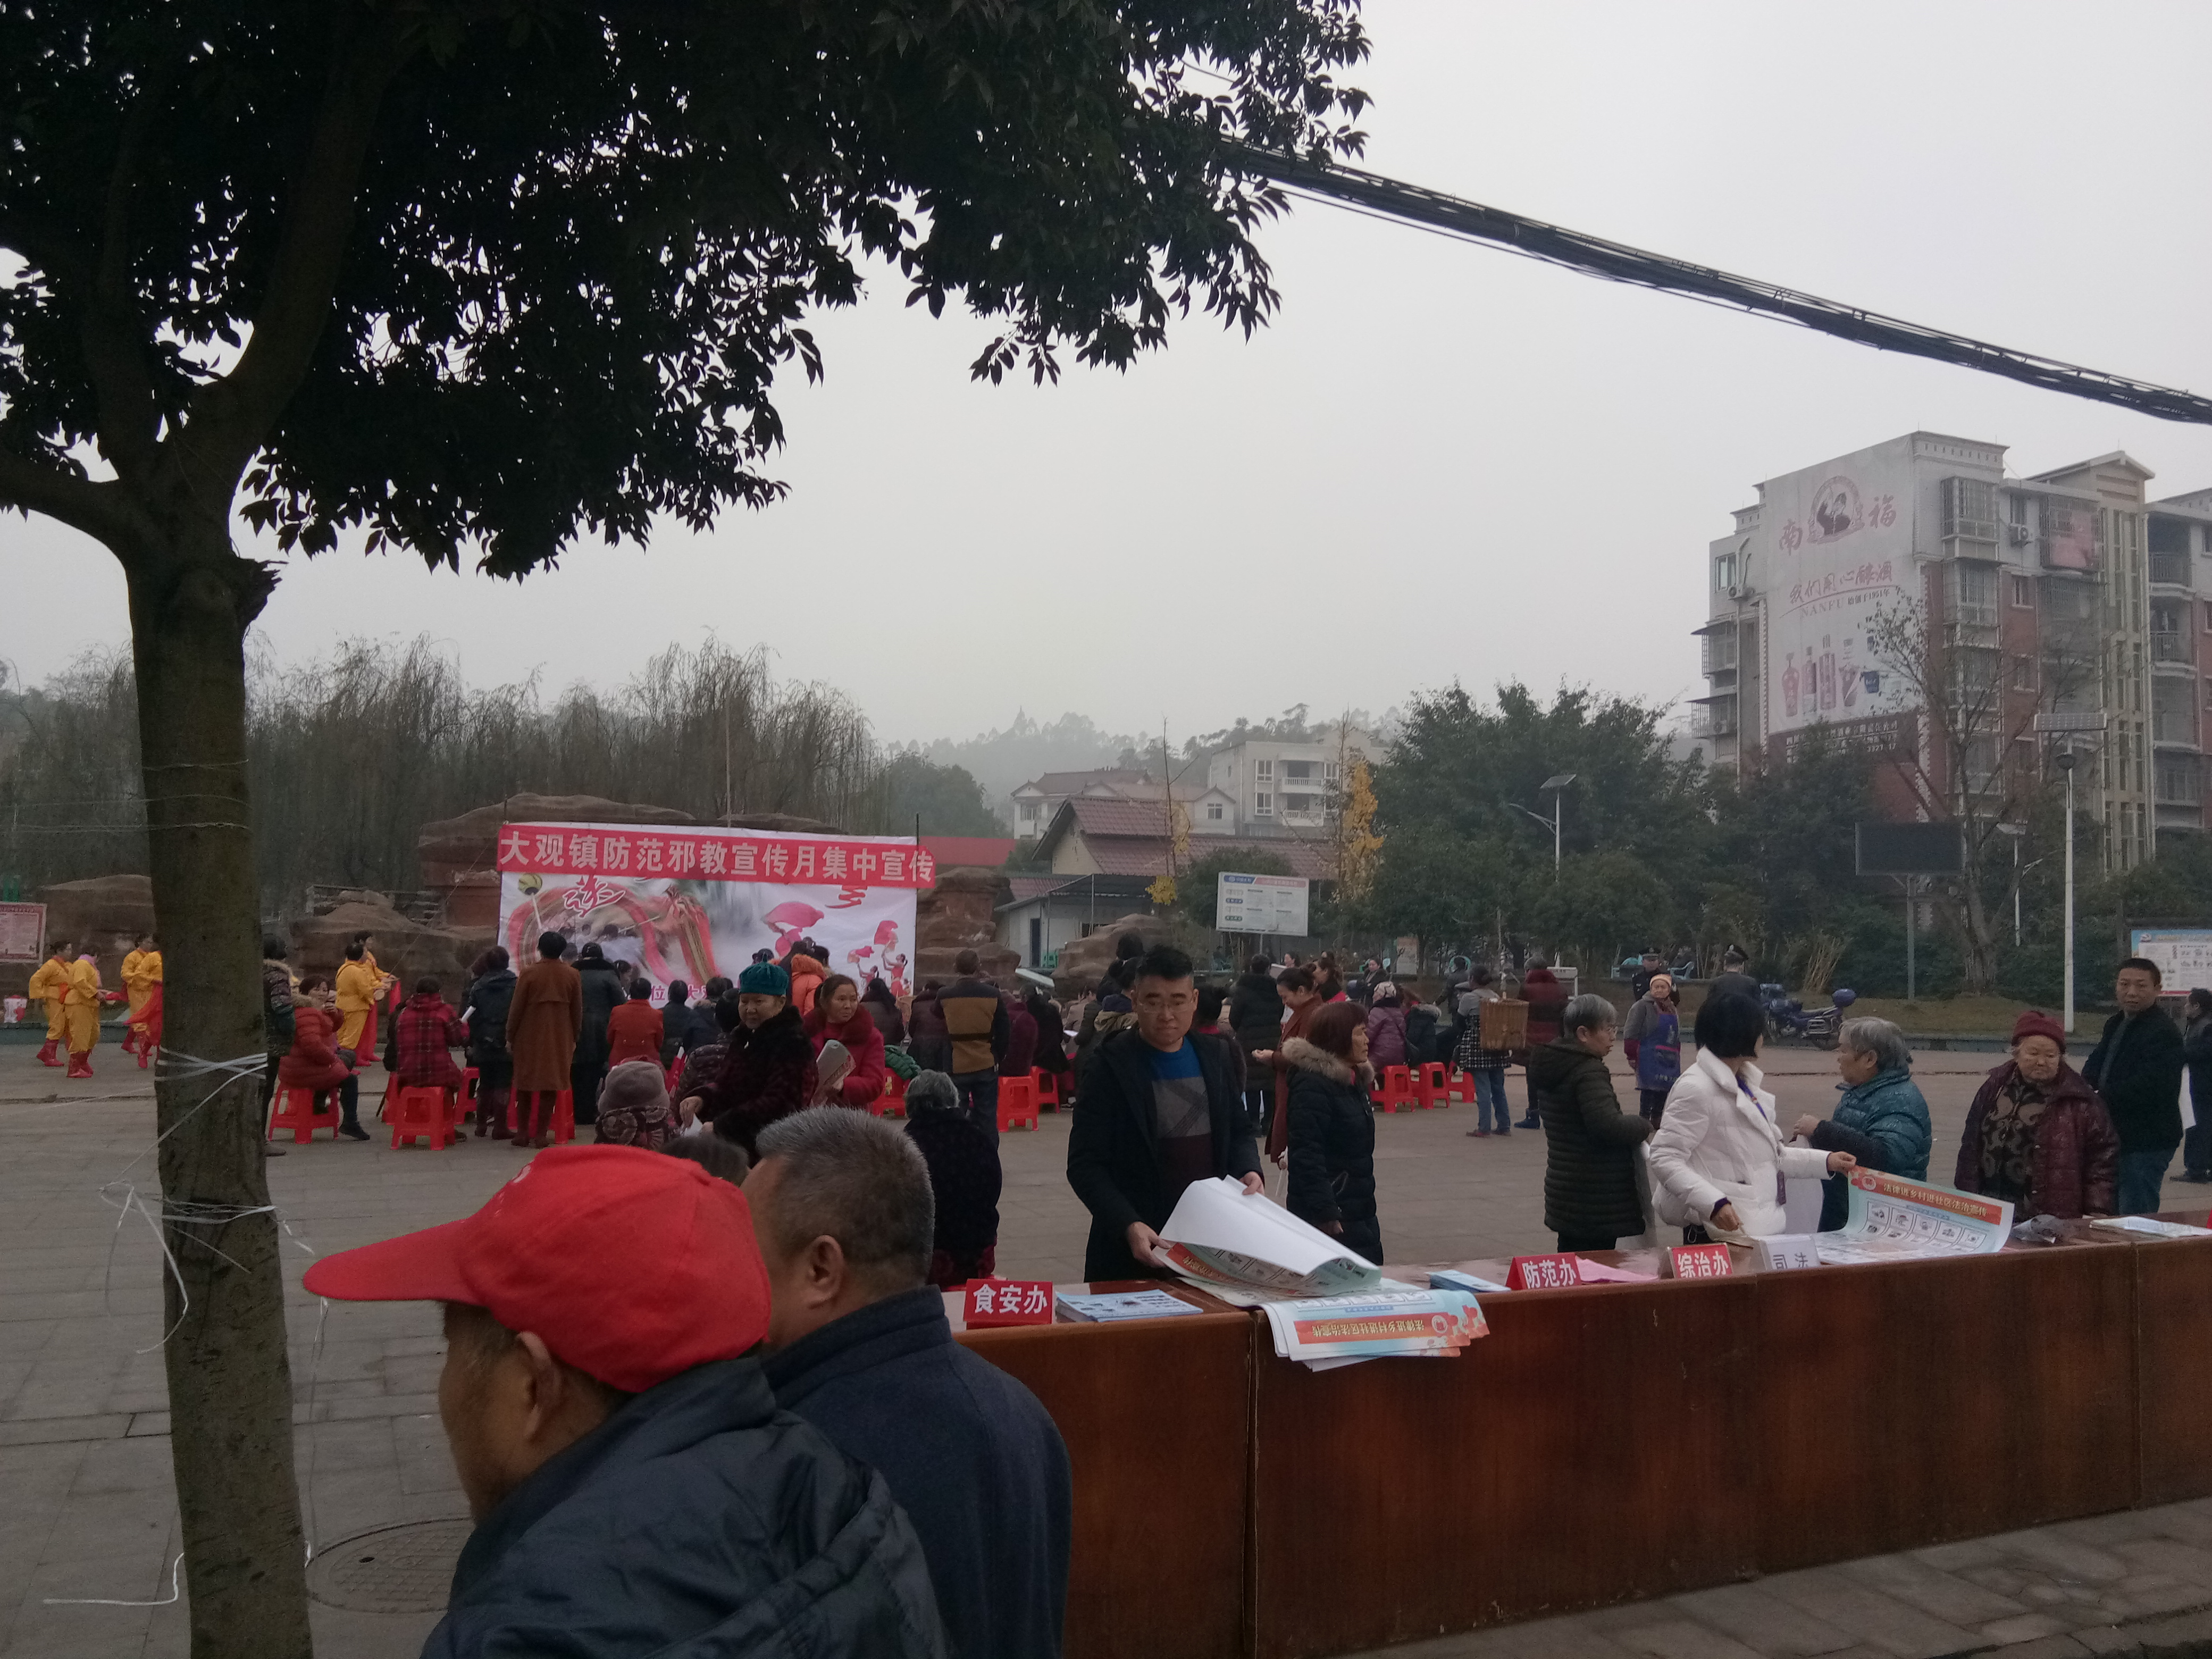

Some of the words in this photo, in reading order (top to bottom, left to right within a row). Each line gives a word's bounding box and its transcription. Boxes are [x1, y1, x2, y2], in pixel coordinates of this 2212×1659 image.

[500, 831, 934, 883] 大观镇防范邪教宣传月集中宣传
[1883, 1183, 1988, 1217] 法律进乡村进社区法治宣传
[1522, 1258, 1577, 1289] 防范办
[1678, 1250, 1729, 1278] 综治办
[973, 1284, 1048, 1314] 食安办
[1311, 1319, 1425, 1338] 法律进乡村进社区法治宣传
